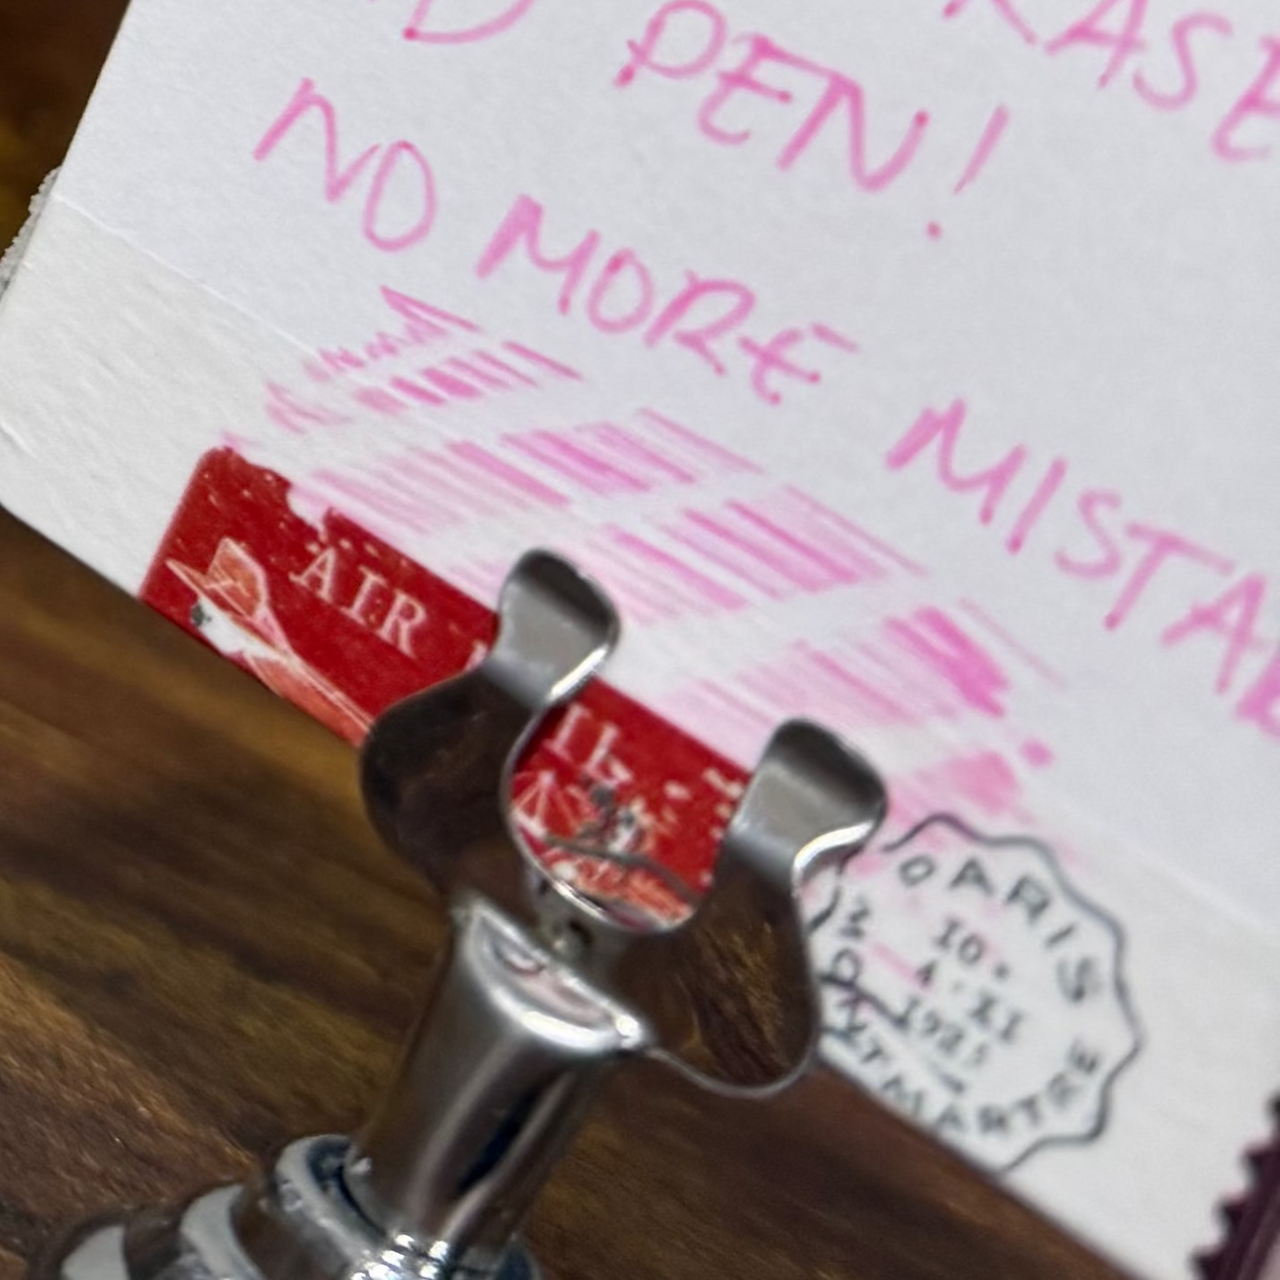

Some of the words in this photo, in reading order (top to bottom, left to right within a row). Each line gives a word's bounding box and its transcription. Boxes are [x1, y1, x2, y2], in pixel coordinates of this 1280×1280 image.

[251, 76, 439, 253] NO
[473, 193, 862, 406] MORE
[288, 541, 429, 659] AIR
